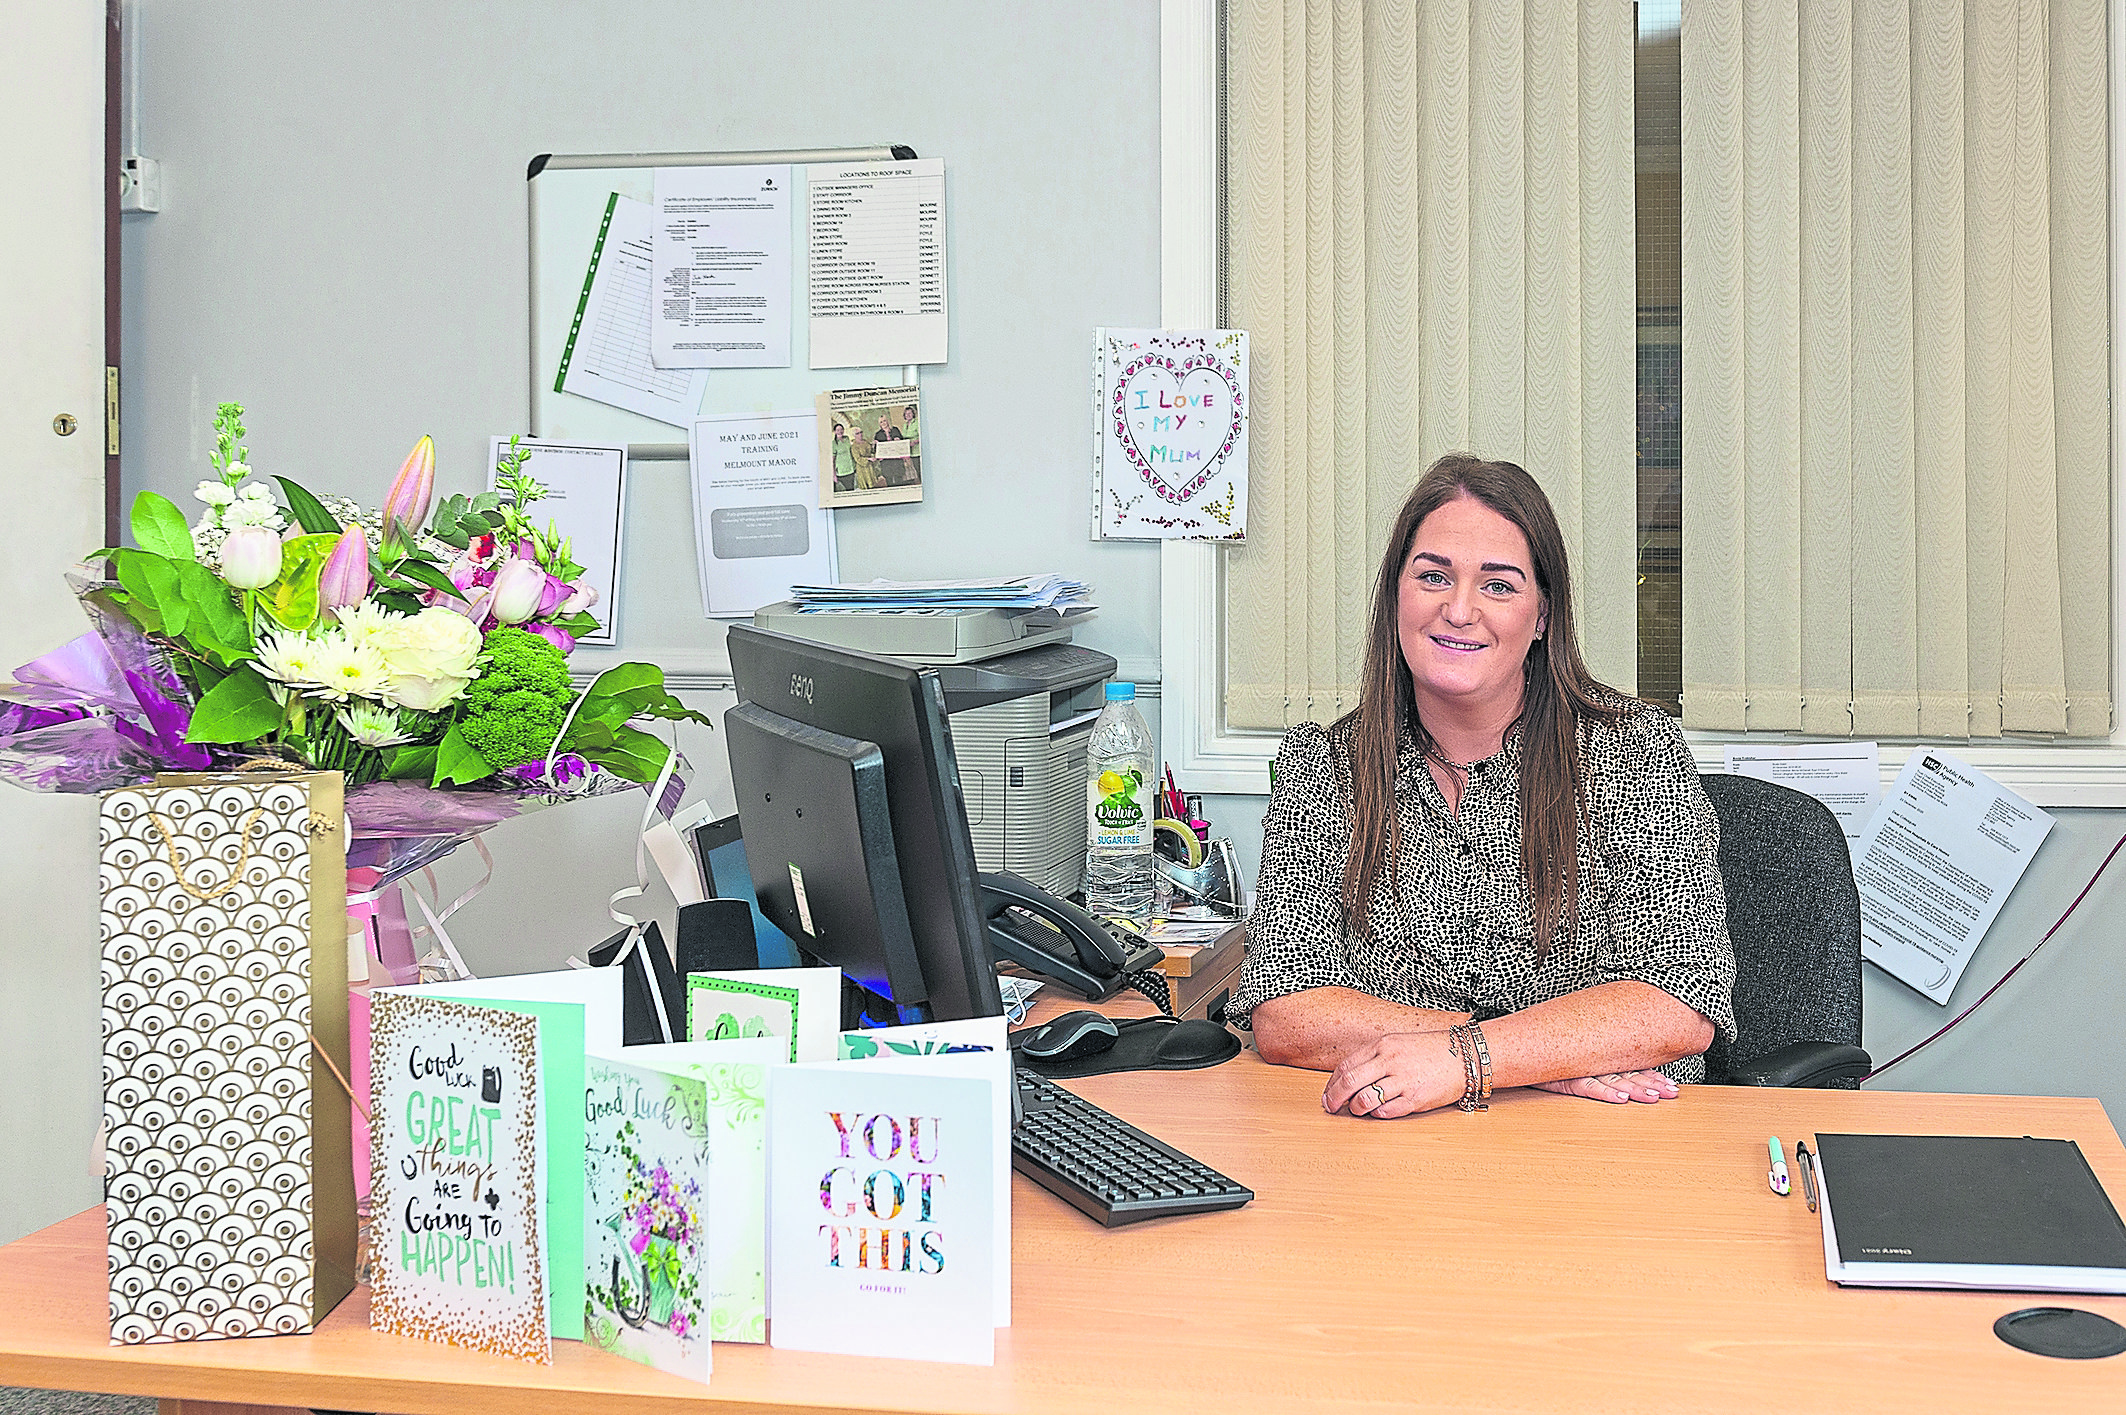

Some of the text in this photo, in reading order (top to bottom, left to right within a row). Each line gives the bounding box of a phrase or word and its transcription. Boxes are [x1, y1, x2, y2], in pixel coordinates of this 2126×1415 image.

[1134, 390, 1213, 410] I LOVE
[1153, 415, 1187, 432] MY
[720, 434, 738, 442] MAY
[741, 445, 778, 453] TRAINING
[1150, 445, 1200, 463] MUM
[724, 458, 797, 469] MELMOUNT MANOR
[1925, 759, 1974, 787] HSC Public Health
[1939, 772, 1958, 786] Agency
[1098, 805, 1139, 818] Volvic
[1098, 836, 1139, 844] SUGAR FREE
[410, 1043, 464, 1080] Good
[586, 1086, 676, 1130] Good Luck
[406, 1090, 502, 1164] GREAT
[824, 1111, 942, 1164] YOU
[416, 1137, 498, 1202] things
[434, 1180, 462, 1198] ARE
[820, 1167, 946, 1223] GOT
[405, 1196, 472, 1241] Going
[819, 1225, 944, 1274] THIS
[401, 1230, 514, 1295] HAPPEN!
[875, 1285, 891, 1293] FOR
